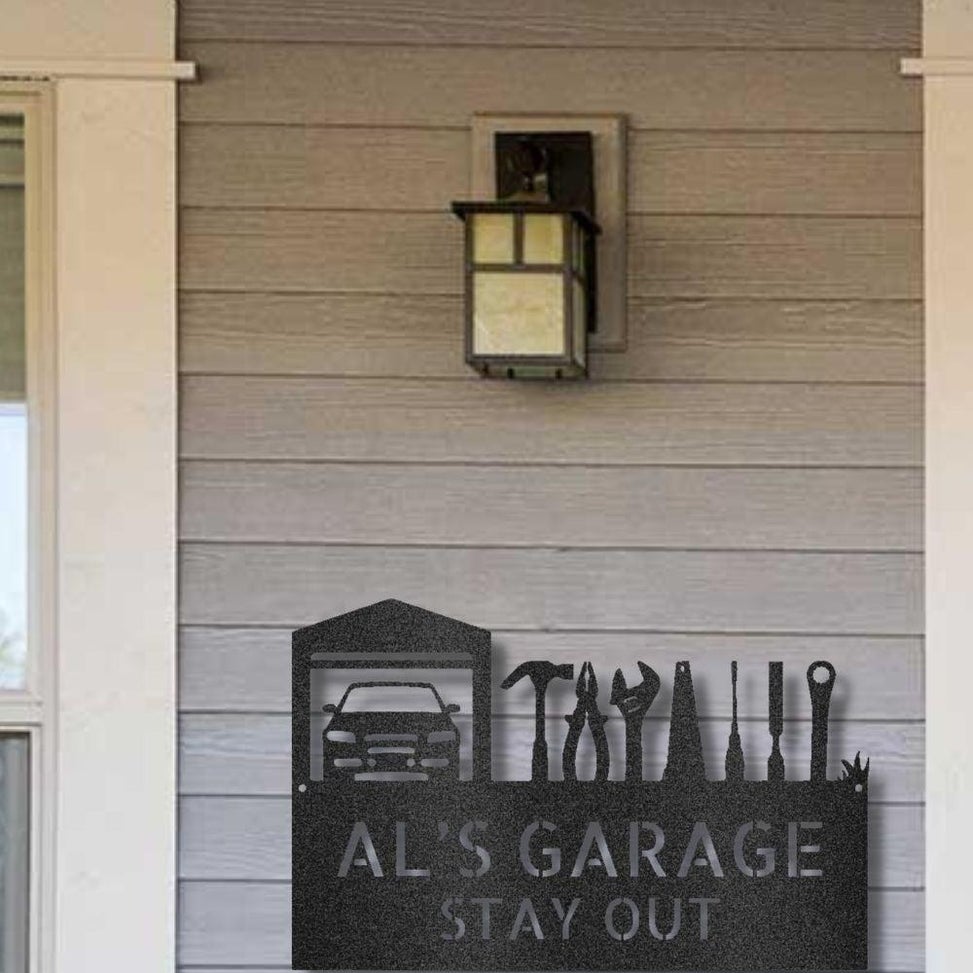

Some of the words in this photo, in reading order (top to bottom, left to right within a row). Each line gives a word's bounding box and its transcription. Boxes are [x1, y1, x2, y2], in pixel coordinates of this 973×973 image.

[337, 821, 493, 878] AL'S
[519, 821, 823, 878] GARAGE
[440, 897, 579, 941] STAY
[604, 897, 721, 941] OUT
